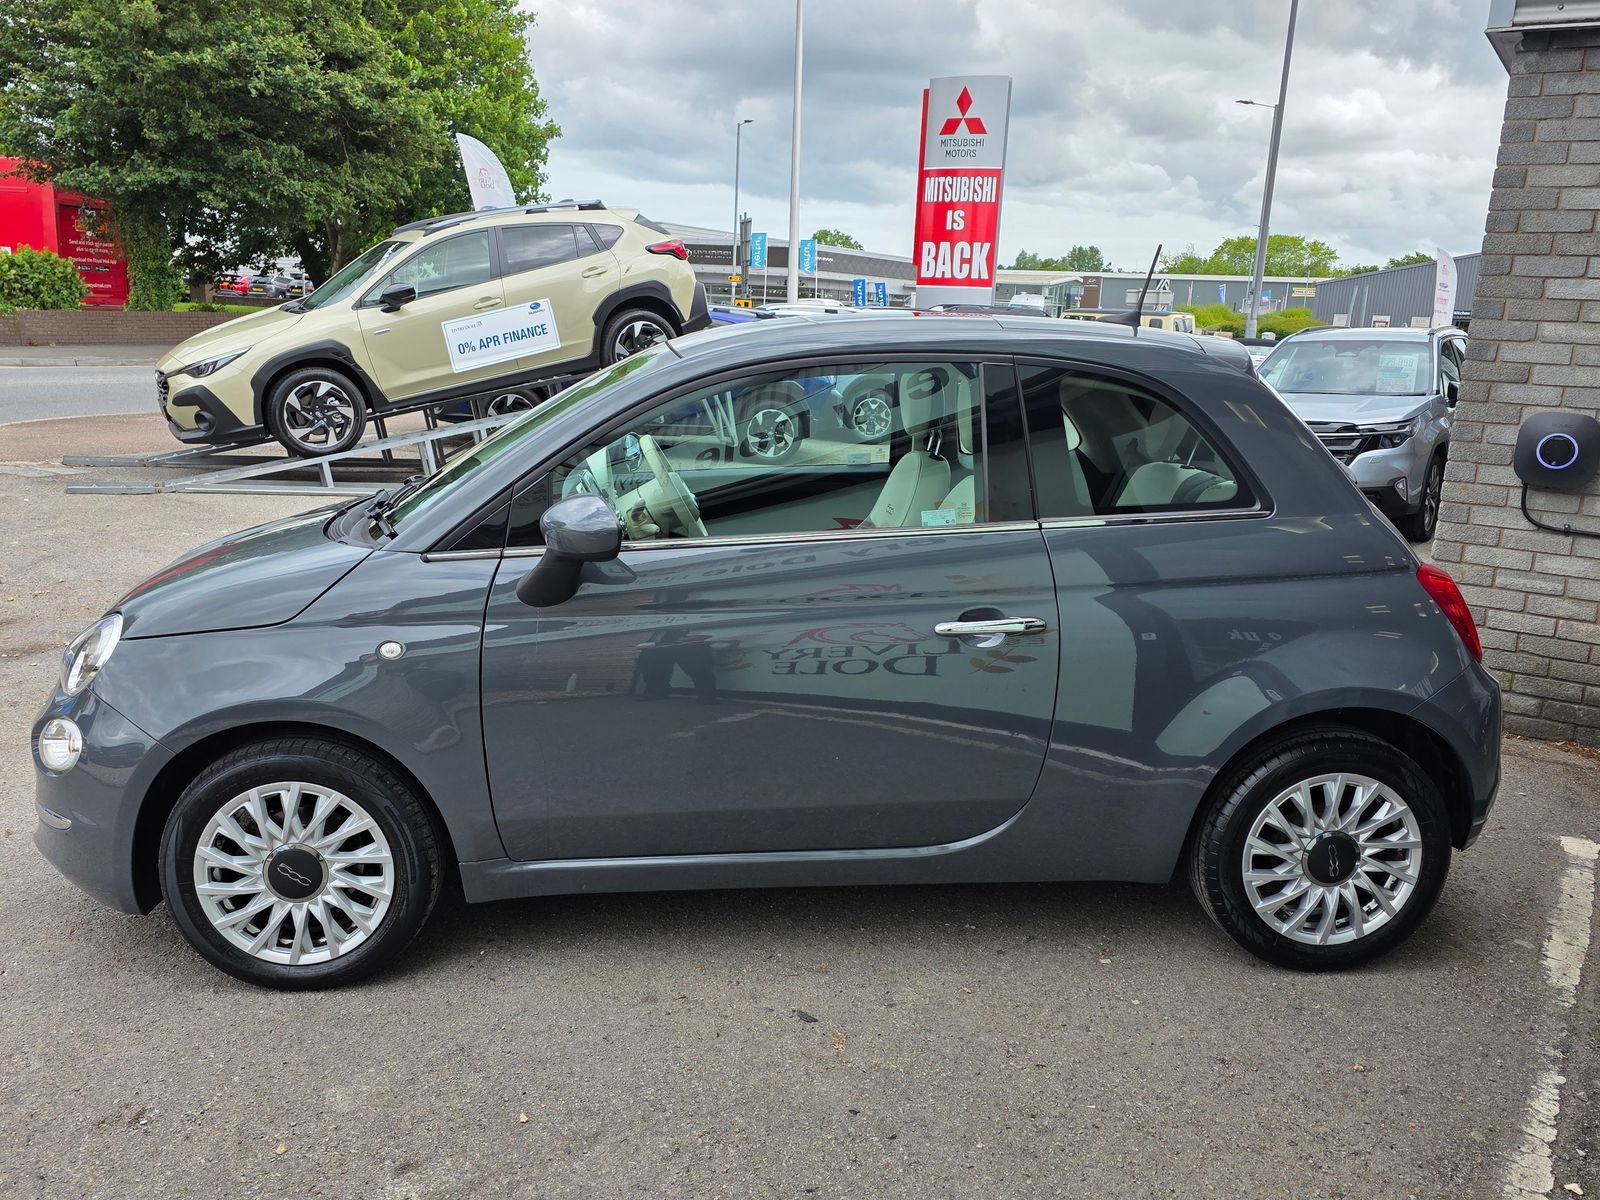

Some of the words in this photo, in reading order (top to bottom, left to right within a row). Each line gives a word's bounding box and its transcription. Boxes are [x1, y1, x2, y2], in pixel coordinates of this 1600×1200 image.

[940, 138, 985, 148] MITSUBISHI
[945, 149, 977, 158] MOTORS
[923, 176, 998, 204] MITSUBISHI
[945, 209, 966, 231] IS
[920, 241, 992, 280] BACK
[457, 340, 476, 355] 0%
[478, 335, 501, 350] APR
[502, 323, 549, 344] FINANCE
